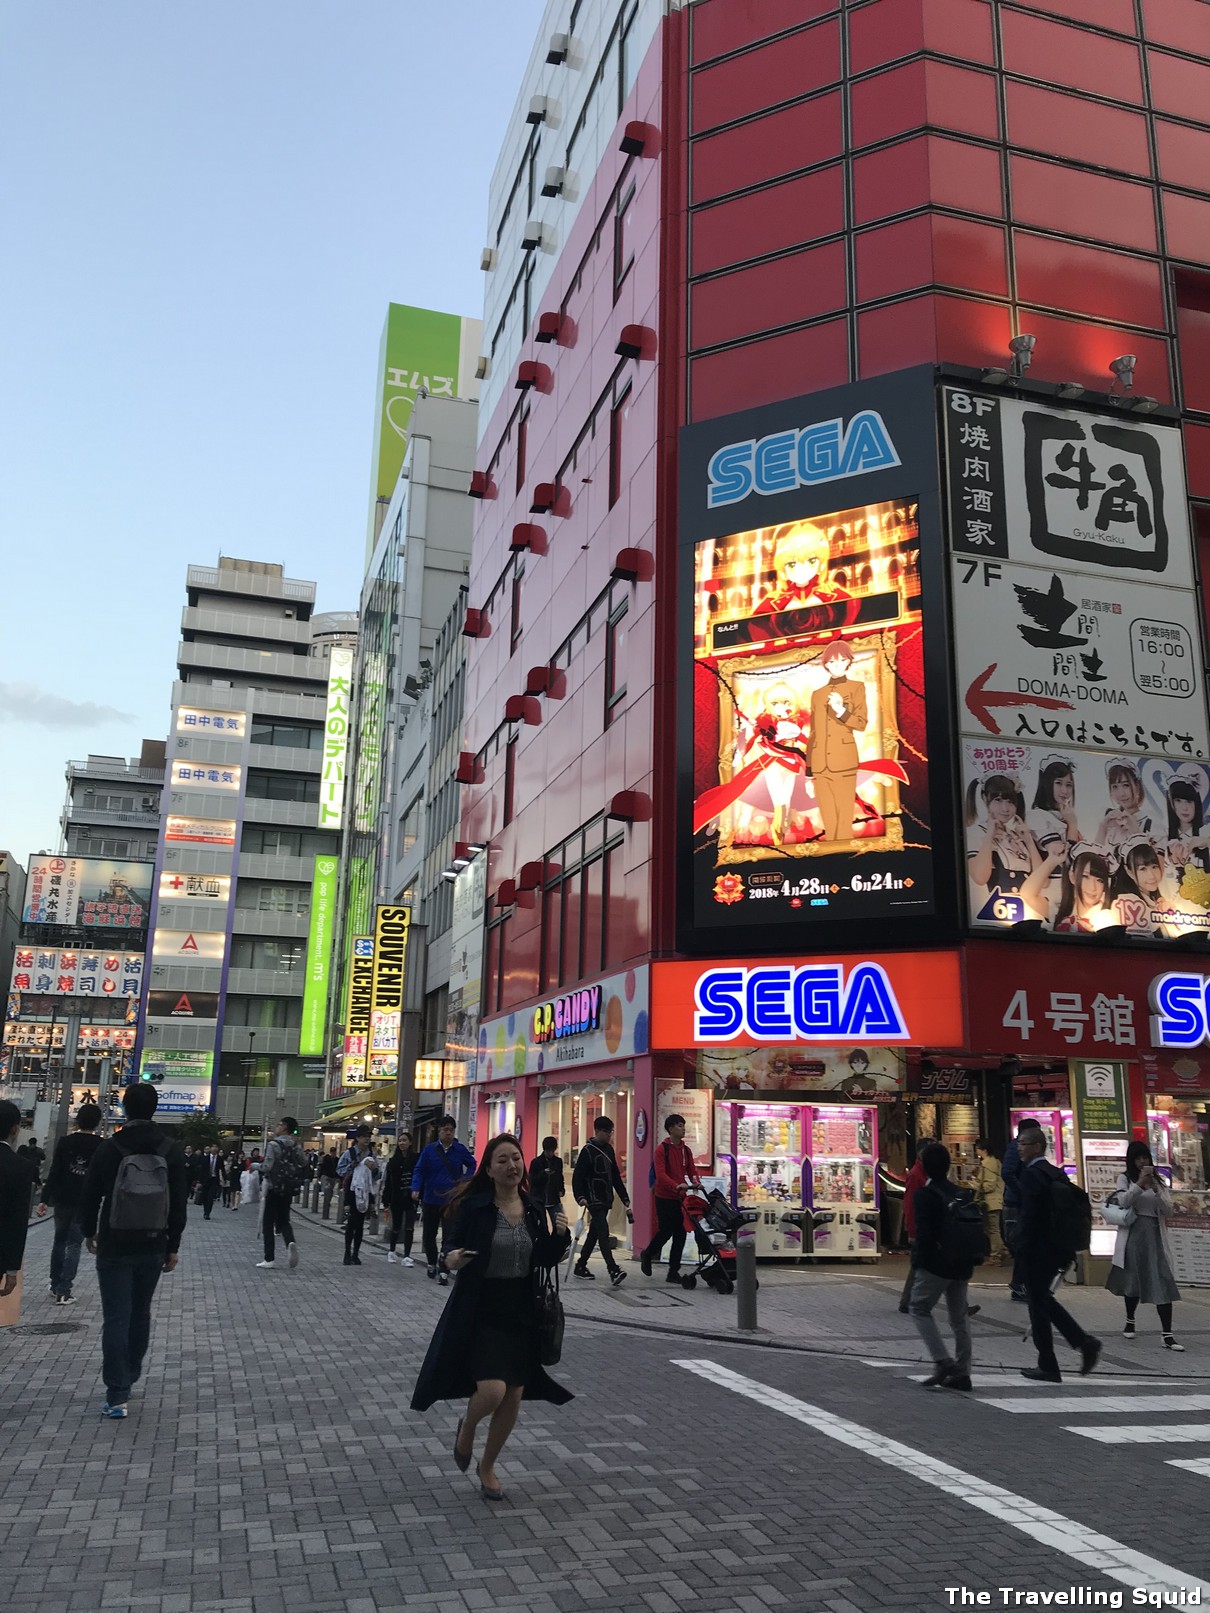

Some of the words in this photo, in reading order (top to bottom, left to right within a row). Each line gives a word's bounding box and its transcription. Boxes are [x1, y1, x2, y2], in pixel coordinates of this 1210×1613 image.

[386, 367, 454, 397] エムズ
[951, 393, 996, 416] 8F
[707, 409, 902, 509] SEGA
[959, 423, 996, 546] 焼肉酒家
[1045, 442, 1153, 538] 牛角
[1072, 528, 1125, 545] Gyu-Kaku
[957, 558, 1002, 587] 7F
[1139, 625, 1181, 641] 営業時間
[1138, 639, 1184, 658] 16:00
[1017, 677, 1129, 706] DOMA-DOMA
[1139, 674, 1190, 692] 翌5:00
[184, 714, 239, 730] 田中電気
[1015, 713, 1204, 758] 入口はこちらです。
[321, 676, 349, 824] 大人のデパート
[973, 747, 1025, 759] ありがとう
[179, 768, 235, 783] 田中電気
[981, 759, 1020, 771] 10周年
[186, 876, 221, 893] 献血
[319, 882, 329, 897] pop
[318, 898, 328, 911] life
[993, 899, 1018, 920] 6F
[13, 951, 34, 990] 活魚
[35, 953, 56, 991] 刺身
[313, 962, 326, 981] m's
[376, 909, 406, 1007] SOUVENIR
[57, 954, 77, 992] 浜焼
[80, 955, 99, 993] 寿司
[102, 956, 120, 993] めし
[122, 957, 141, 995] 活貝
[350, 958, 373, 1035] EXCHANGE
[694, 961, 911, 1042] SEGA
[1148, 971, 1210, 1048] S
[1002, 989, 1137, 1046] 4号館
[556, 1044, 584, 1062] Akihabara
[671, 1096, 695, 1105] MENU
